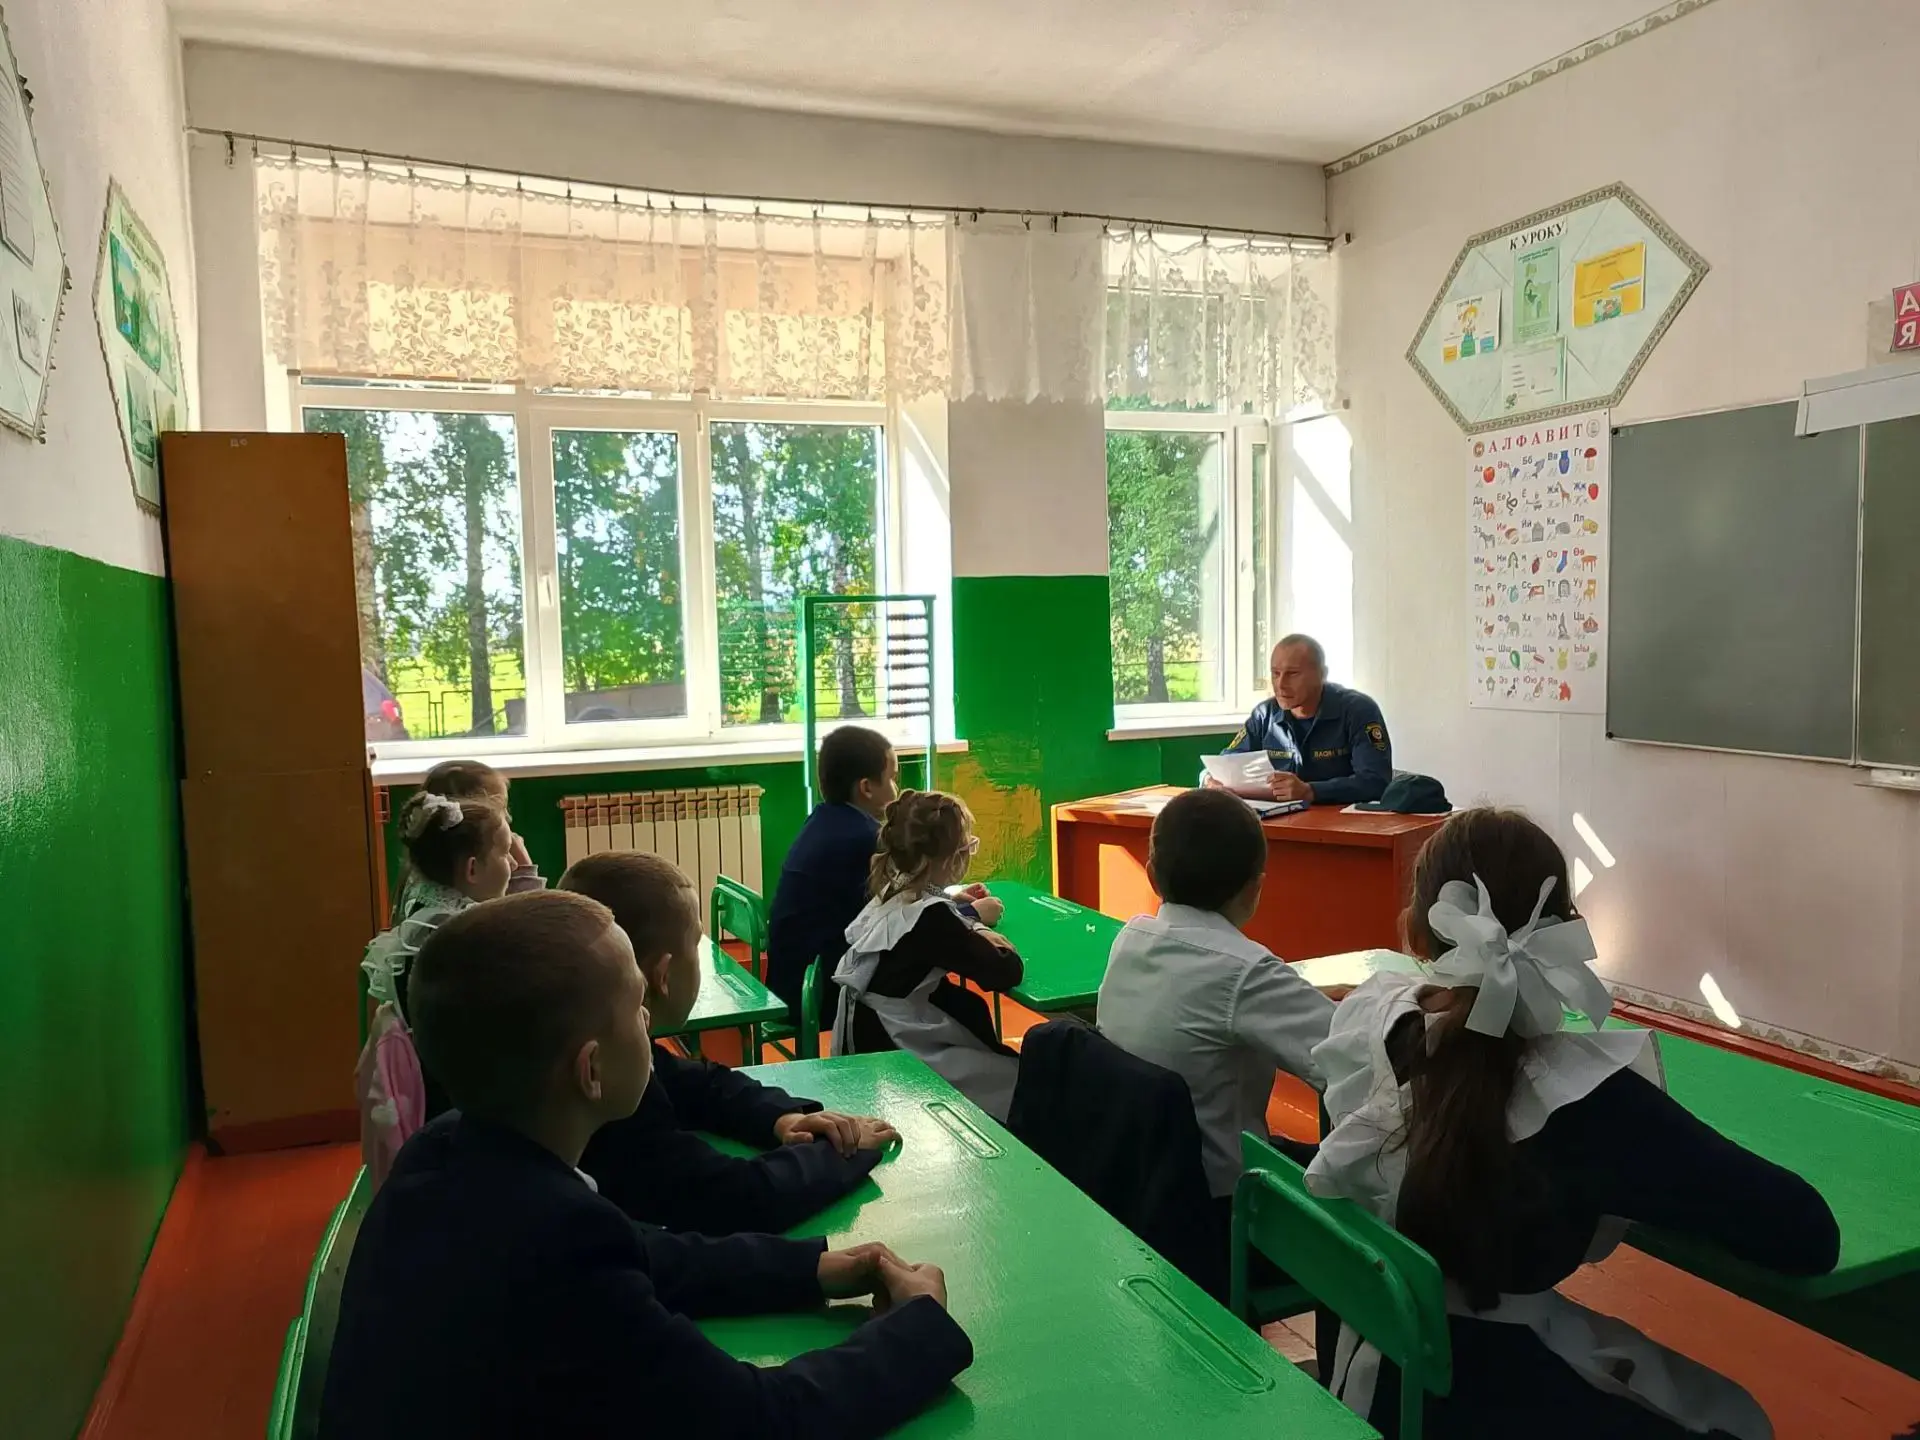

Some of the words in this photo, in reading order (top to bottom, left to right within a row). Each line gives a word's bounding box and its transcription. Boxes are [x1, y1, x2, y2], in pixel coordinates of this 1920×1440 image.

[1509, 235, 1519, 251] К
[1521, 222, 1565, 247] УРОКУ
[1899, 289, 1920, 315] А
[1897, 320, 1917, 346] Я
[1488, 424, 1583, 454] АЛФАВИТ
